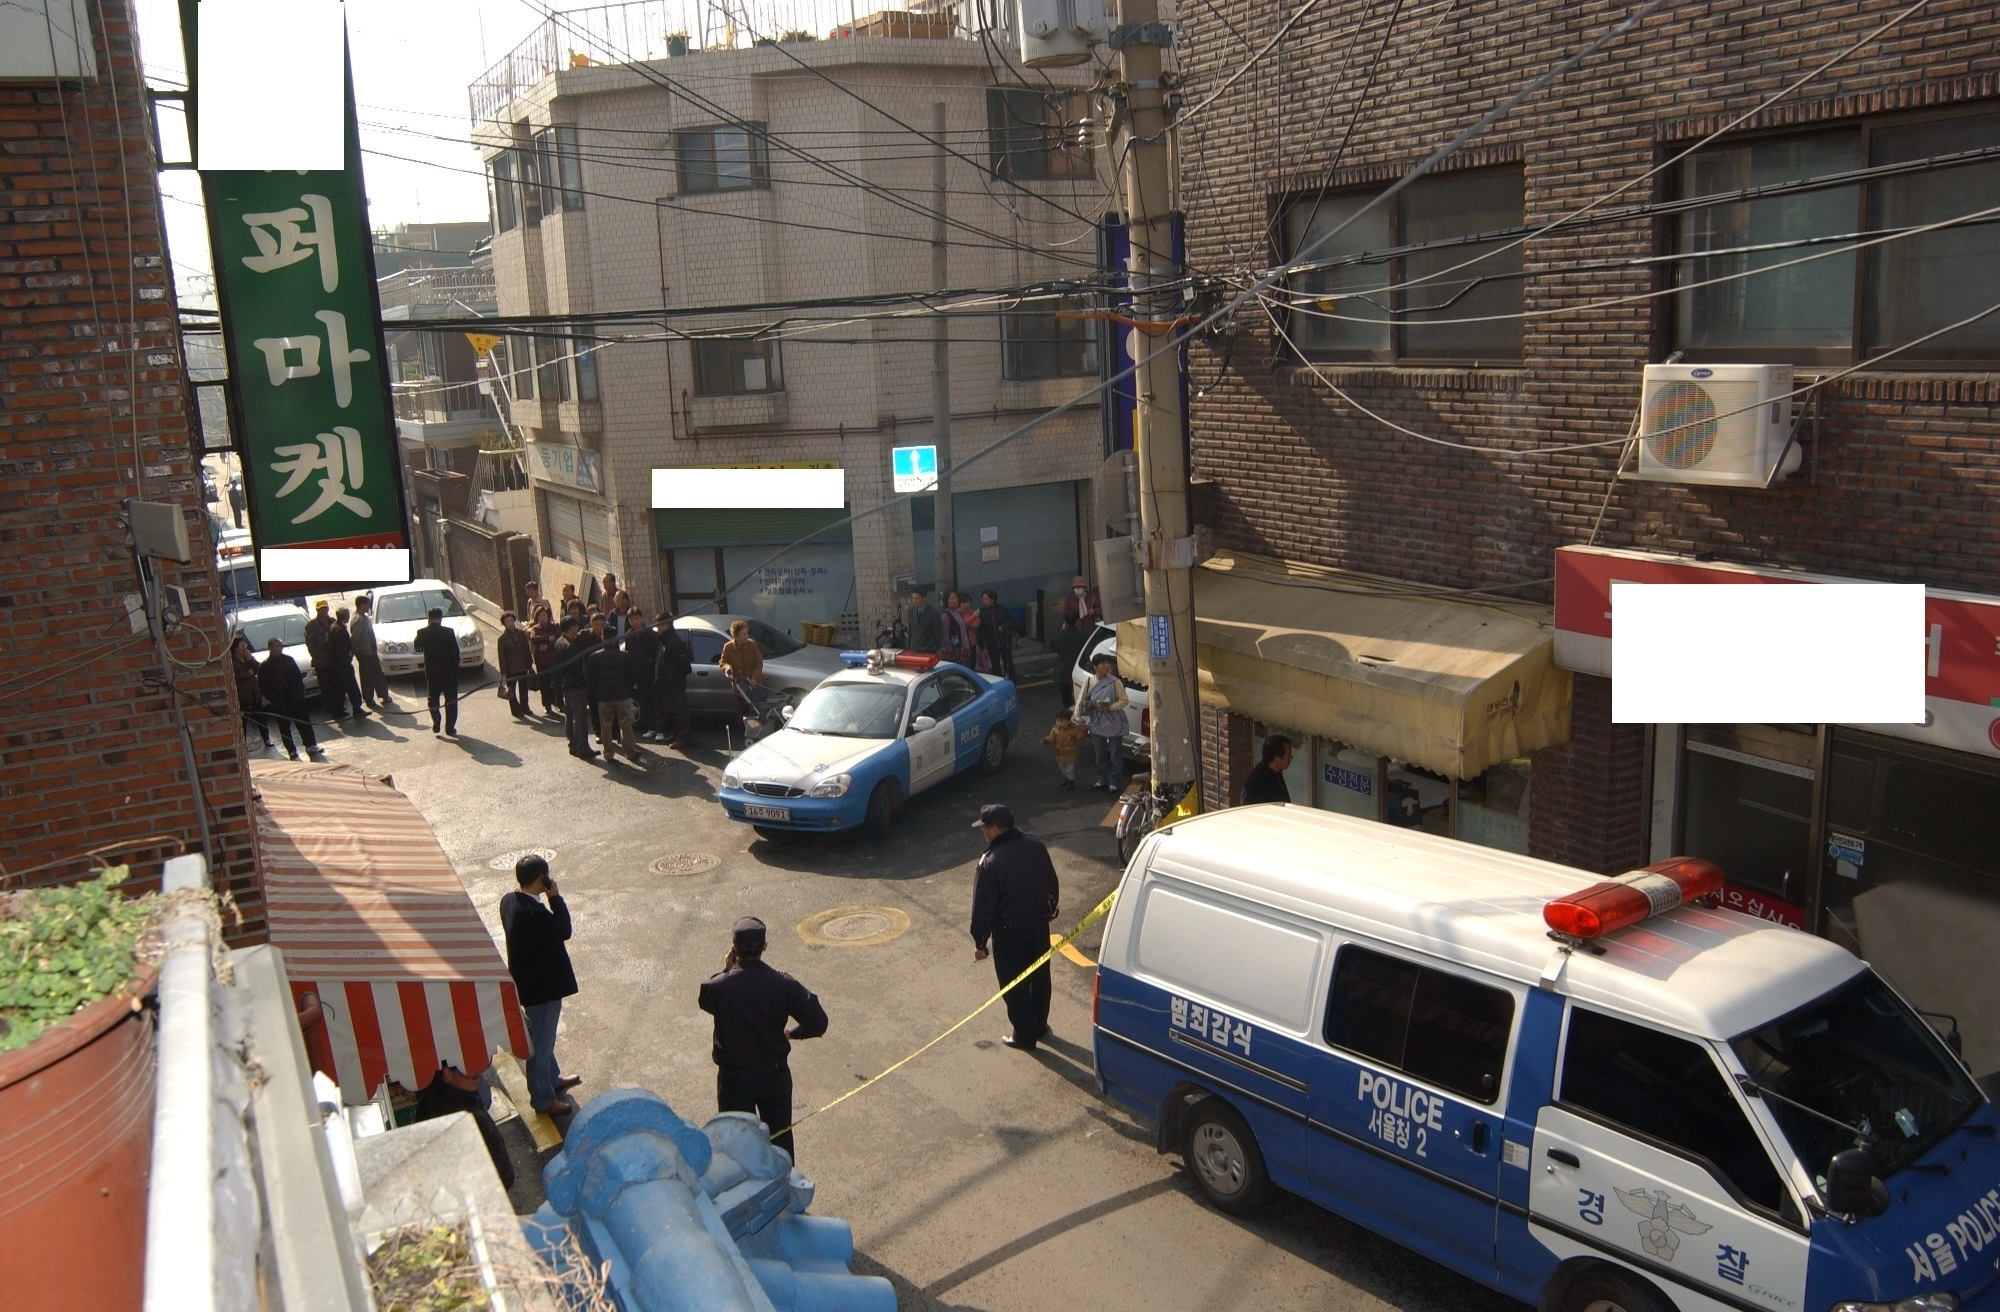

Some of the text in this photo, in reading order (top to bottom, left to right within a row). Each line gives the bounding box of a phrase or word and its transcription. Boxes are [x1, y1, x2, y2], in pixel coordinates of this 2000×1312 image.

[242, 171, 373, 525] 퍼마켓
[960, 724, 980, 746] POLICE
[1326, 765, 1371, 795] 수선전문
[765, 808, 786, 820] 9091
[1706, 886, 1801, 930] 서오십시
[1171, 995, 1252, 1056] 범죄감식
[1358, 1069, 1445, 1132] POLICE
[1368, 1108, 1427, 1158] 서울청 2
[1577, 1187, 1605, 1226] 경
[1715, 1243, 1750, 1286] 찰
[1905, 1232, 1958, 1284] 서울
[1747, 1282, 1796, 1308] Grace
